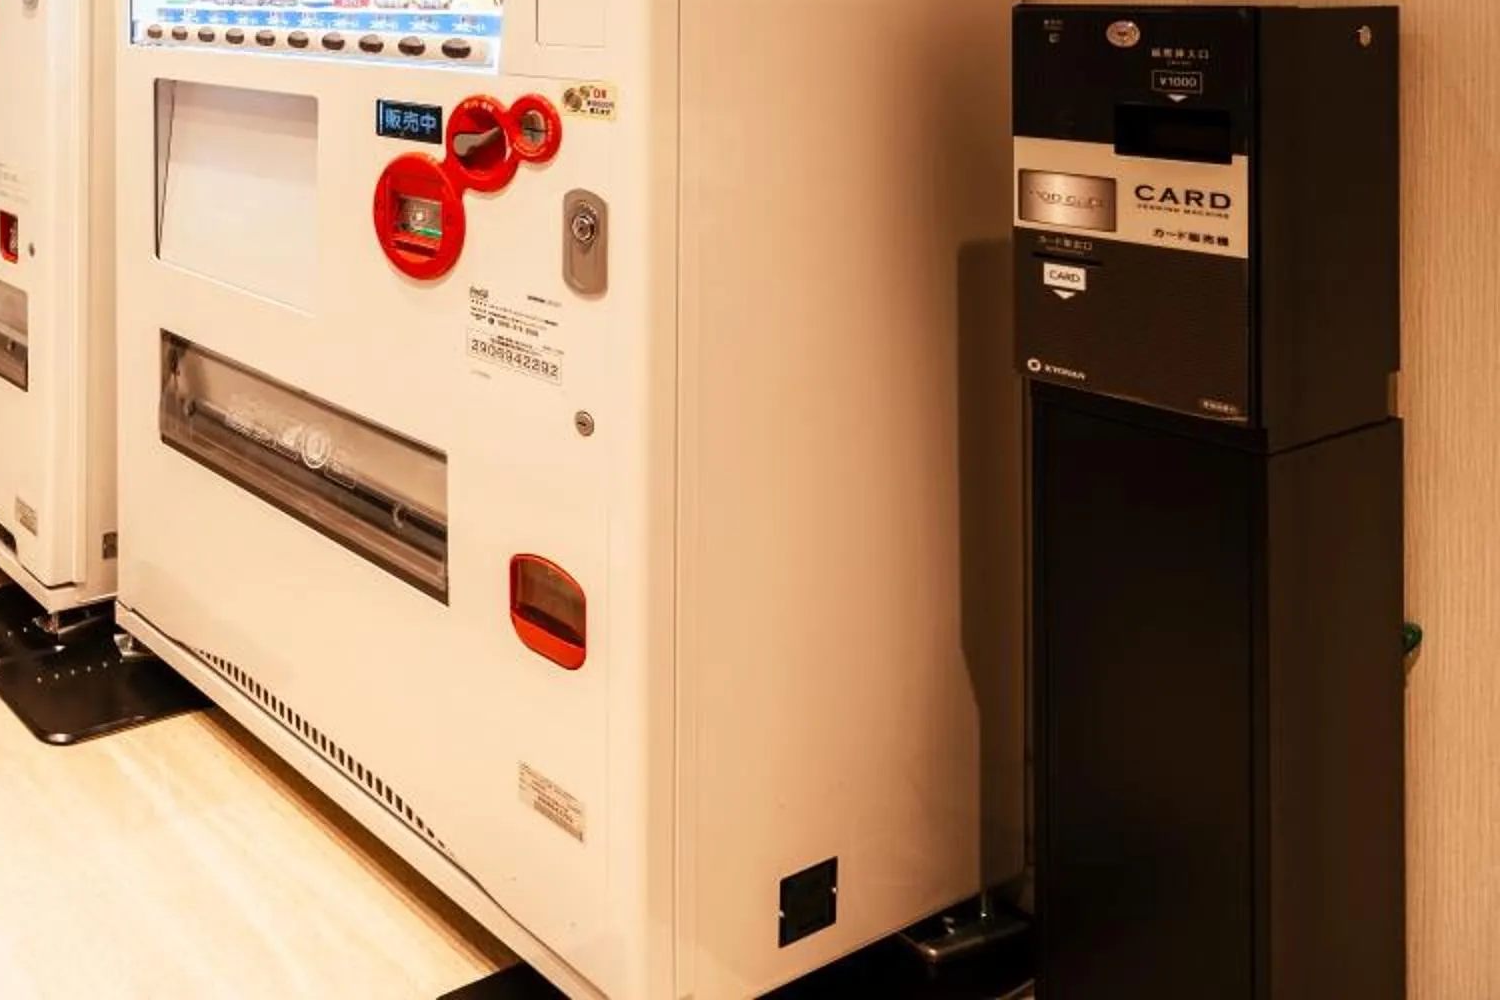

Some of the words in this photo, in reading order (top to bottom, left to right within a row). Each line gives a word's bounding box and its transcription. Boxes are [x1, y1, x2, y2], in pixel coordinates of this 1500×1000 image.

[384, 108, 437, 135] 販売中
[1134, 184, 1231, 210] CARD
[1049, 269, 1081, 284] CARD
